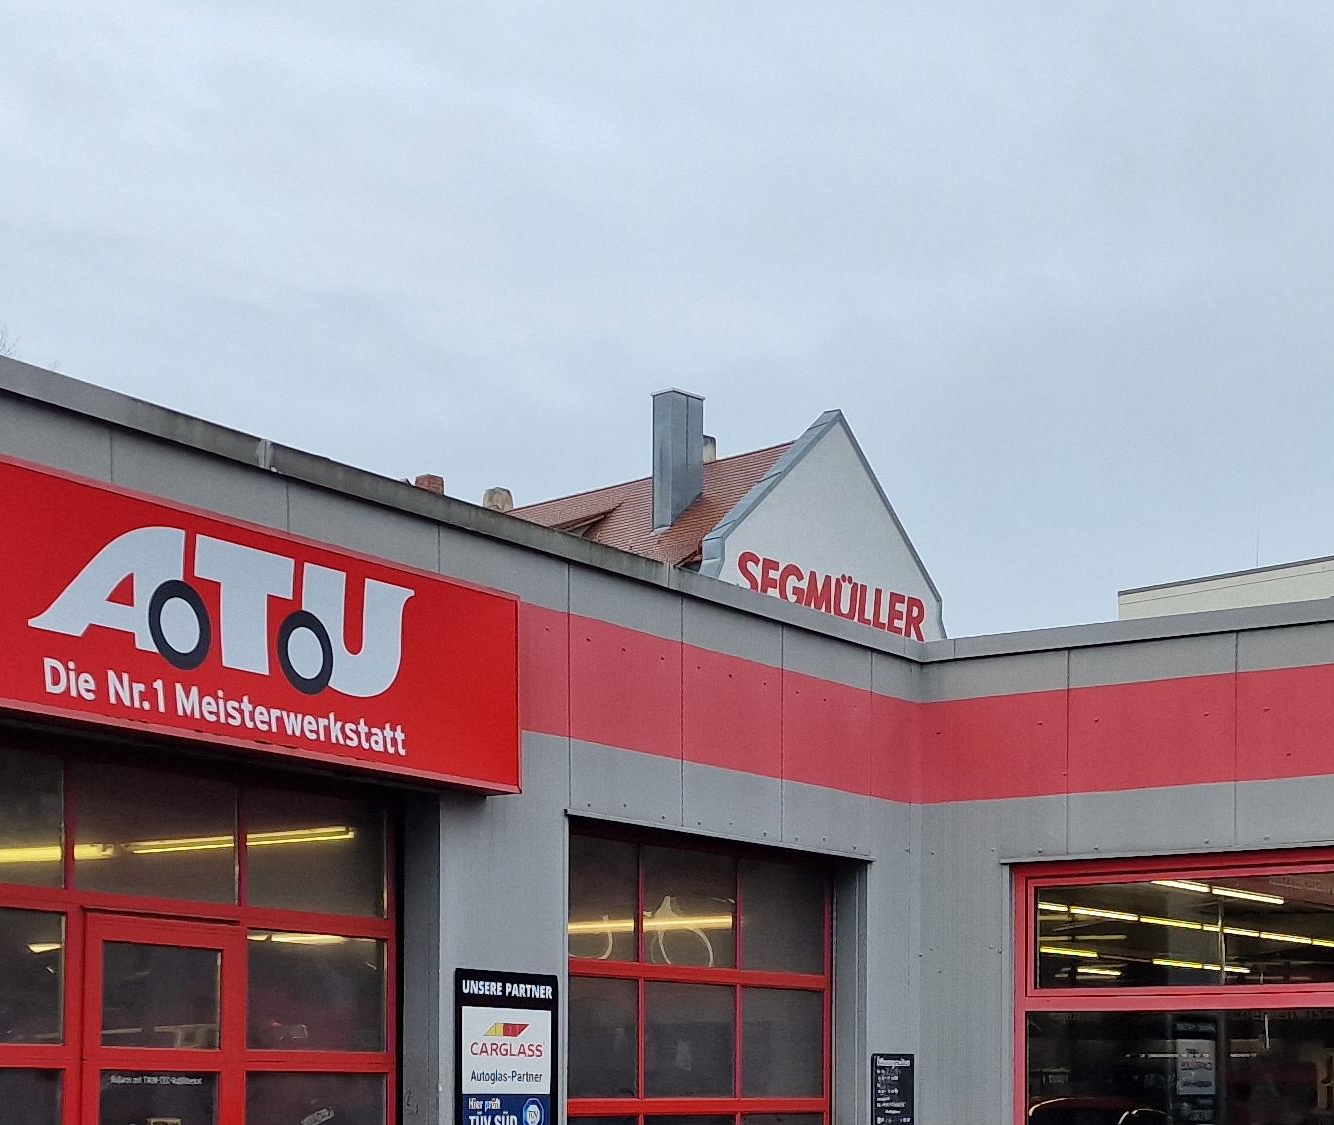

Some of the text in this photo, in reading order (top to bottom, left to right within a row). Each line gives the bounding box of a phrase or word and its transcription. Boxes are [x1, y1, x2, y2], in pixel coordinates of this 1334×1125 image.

[737, 551, 925, 642] SEGMÜLLER
[43, 656, 407, 757] Die Nr.1 Meisterwerkstatt
[462, 980, 553, 1000] UNSERE PARTNER
[470, 1042, 543, 1058] CARGLASS
[470, 1069, 543, 1085] Autoglas-Partner
